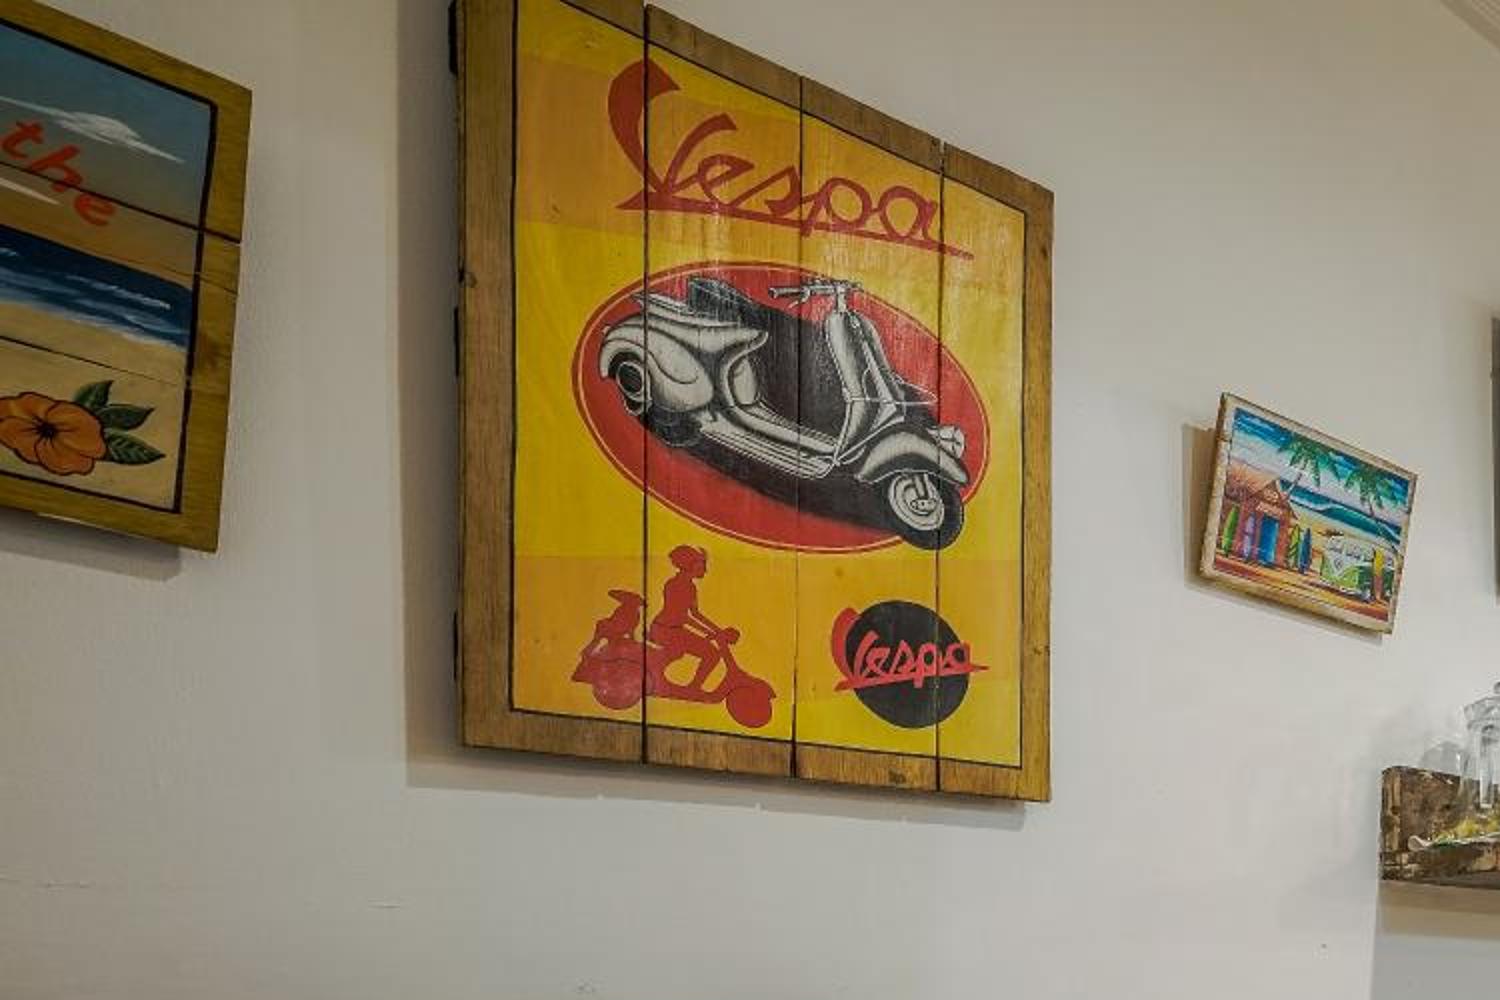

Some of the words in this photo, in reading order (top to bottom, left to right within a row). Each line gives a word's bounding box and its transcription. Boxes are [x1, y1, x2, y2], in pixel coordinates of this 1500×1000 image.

[1, 120, 116, 227] the
[607, 58, 974, 260] Vespa
[831, 607, 991, 692] Vespa
